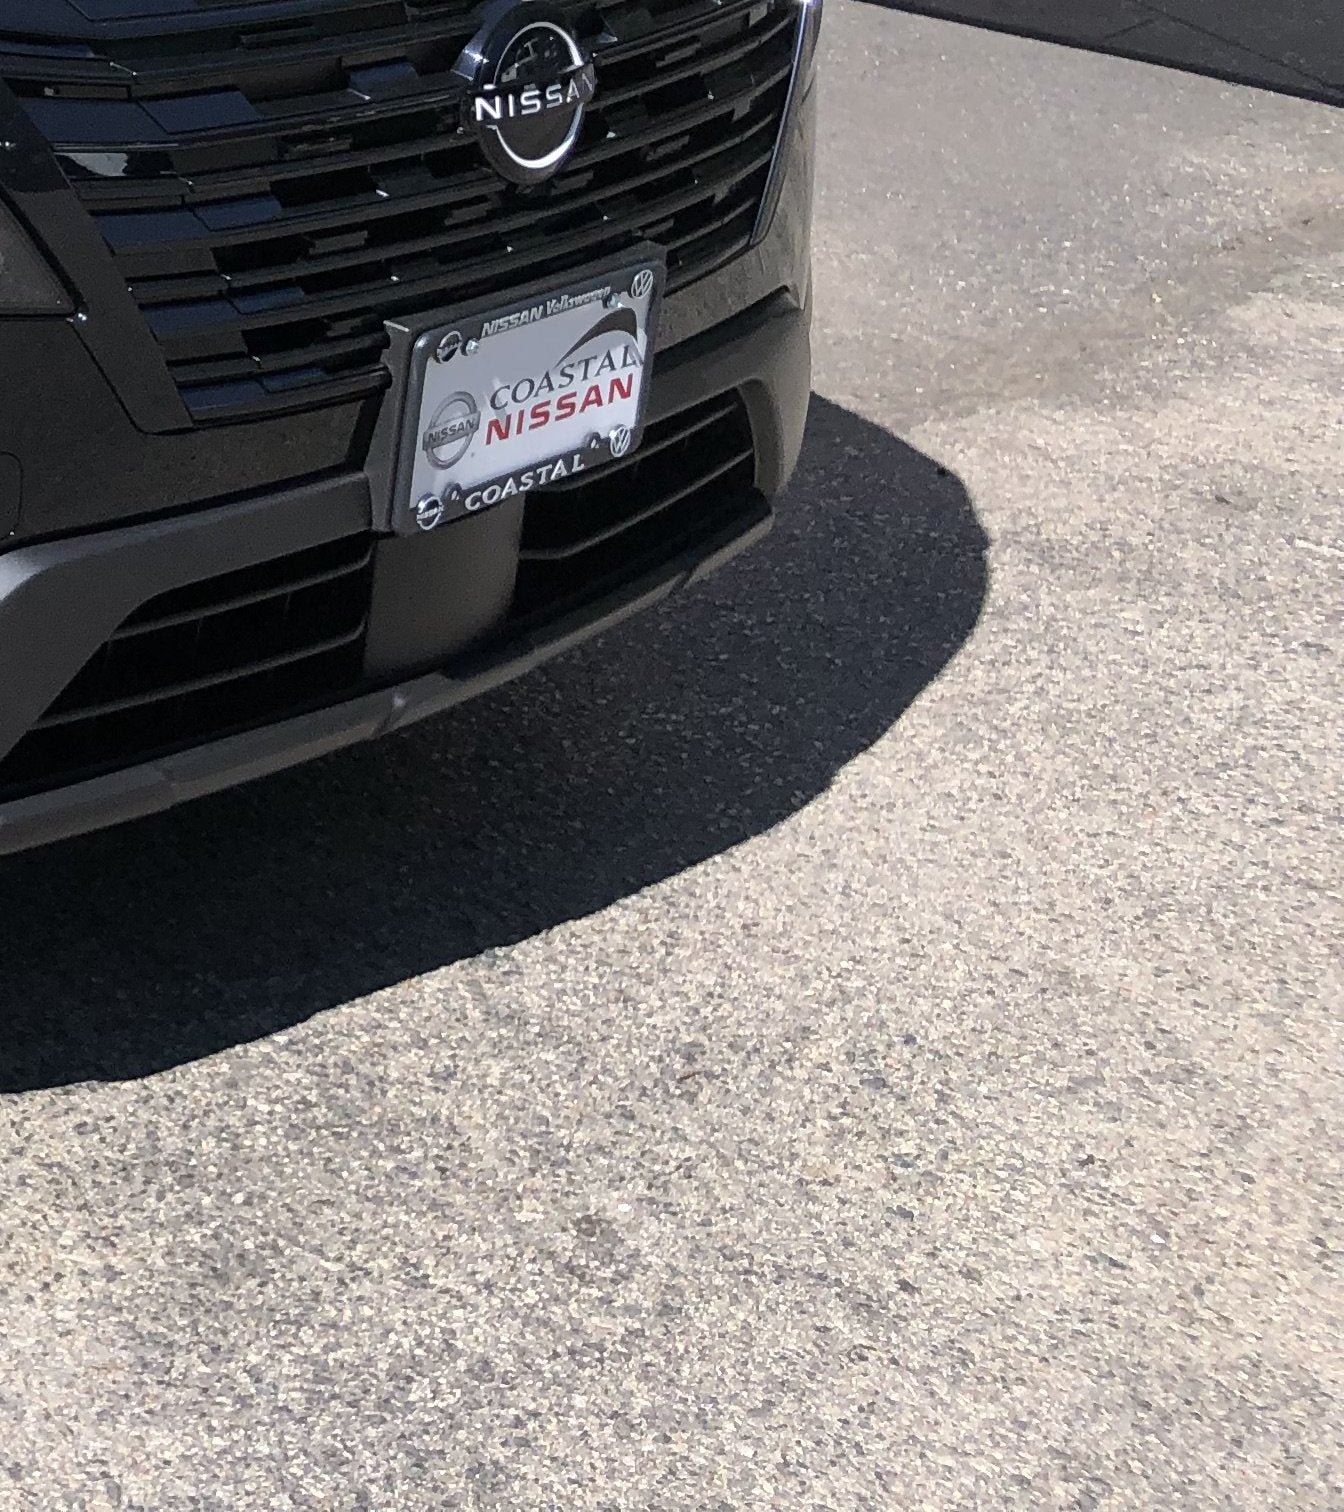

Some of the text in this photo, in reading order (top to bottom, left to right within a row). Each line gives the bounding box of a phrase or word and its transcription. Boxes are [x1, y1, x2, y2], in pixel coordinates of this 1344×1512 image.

[474, 72, 594, 122] NISSAN
[481, 304, 544, 338] NISSAN
[490, 343, 644, 411] COASTAL
[427, 417, 476, 441] NISSAN
[485, 373, 634, 446] NISSAN
[464, 453, 585, 511] COASTAL
